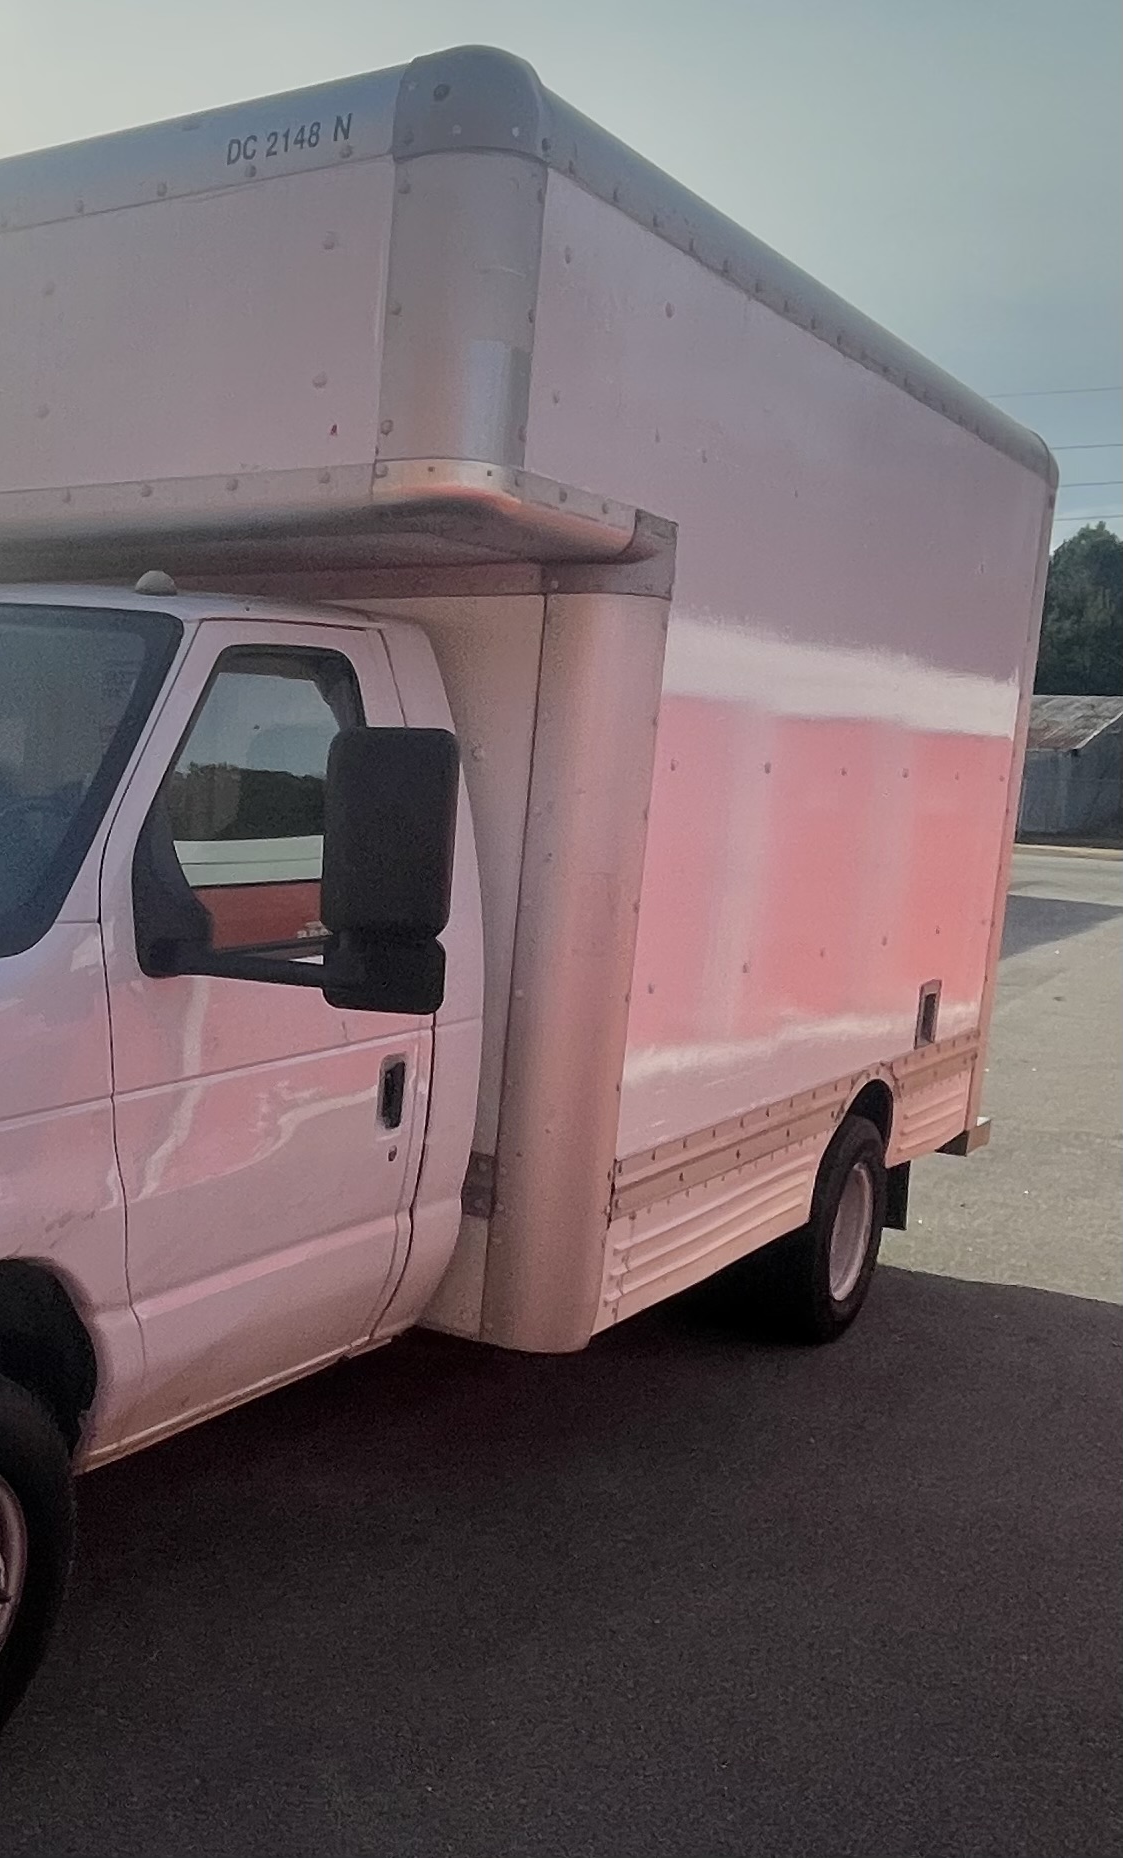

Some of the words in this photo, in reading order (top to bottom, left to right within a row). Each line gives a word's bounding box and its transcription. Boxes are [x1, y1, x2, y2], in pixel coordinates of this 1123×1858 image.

[226, 134, 258, 166] DC
[265, 121, 321, 158] 2148
[332, 112, 353, 142] N
